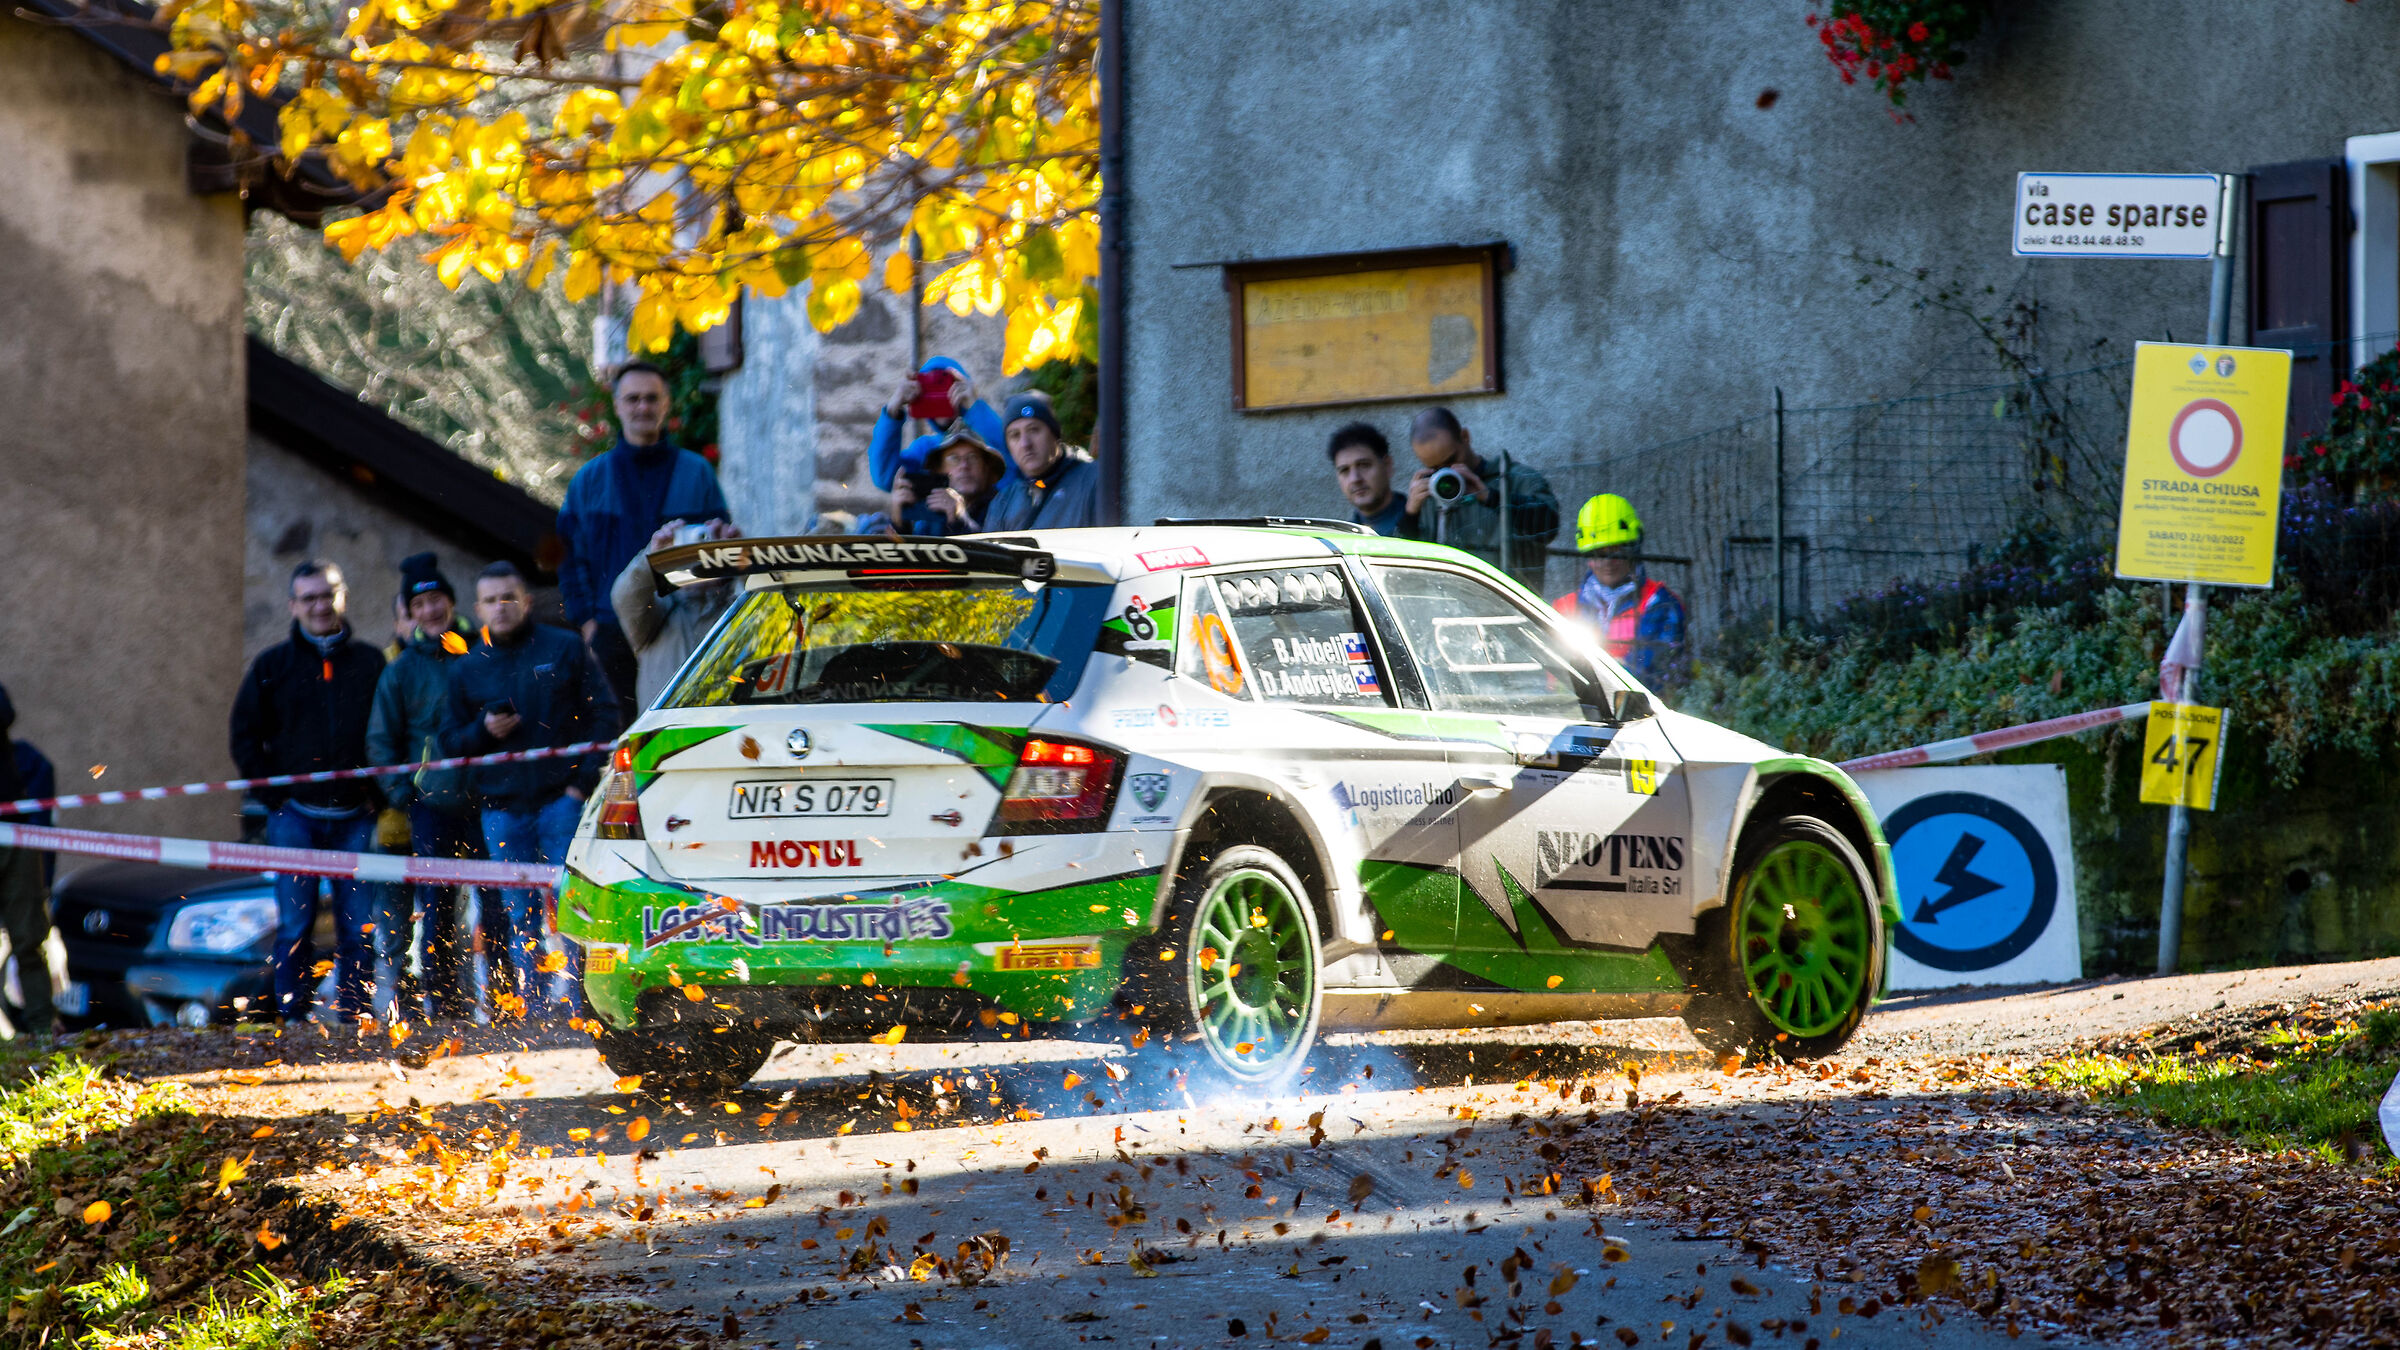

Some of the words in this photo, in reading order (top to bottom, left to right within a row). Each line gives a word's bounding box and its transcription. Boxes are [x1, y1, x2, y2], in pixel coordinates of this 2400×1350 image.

[2027, 181, 2049, 196] via
[2025, 203, 2095, 226] case
[2106, 203, 2208, 232] sparse
[2141, 479, 2200, 494] STRADA
[2203, 482, 2260, 497] CHIUSA
[751, 543, 969, 566] MUNARETTO
[1189, 612, 1244, 694] 19
[1271, 636, 1349, 667] B.Avbelj
[1258, 668, 1357, 700] D.Andrejka
[2151, 733, 2210, 775] 47
[736, 786, 782, 813] NR
[795, 785, 815, 812] S
[826, 785, 882, 812] 079
[1350, 782, 1454, 812] LogisticaUno
[749, 839, 864, 869] MOTUL
[1536, 830, 1684, 877] NEOTENS
[1628, 875, 1659, 895] Italia
[761, 896, 954, 941] INDUSTRIES
